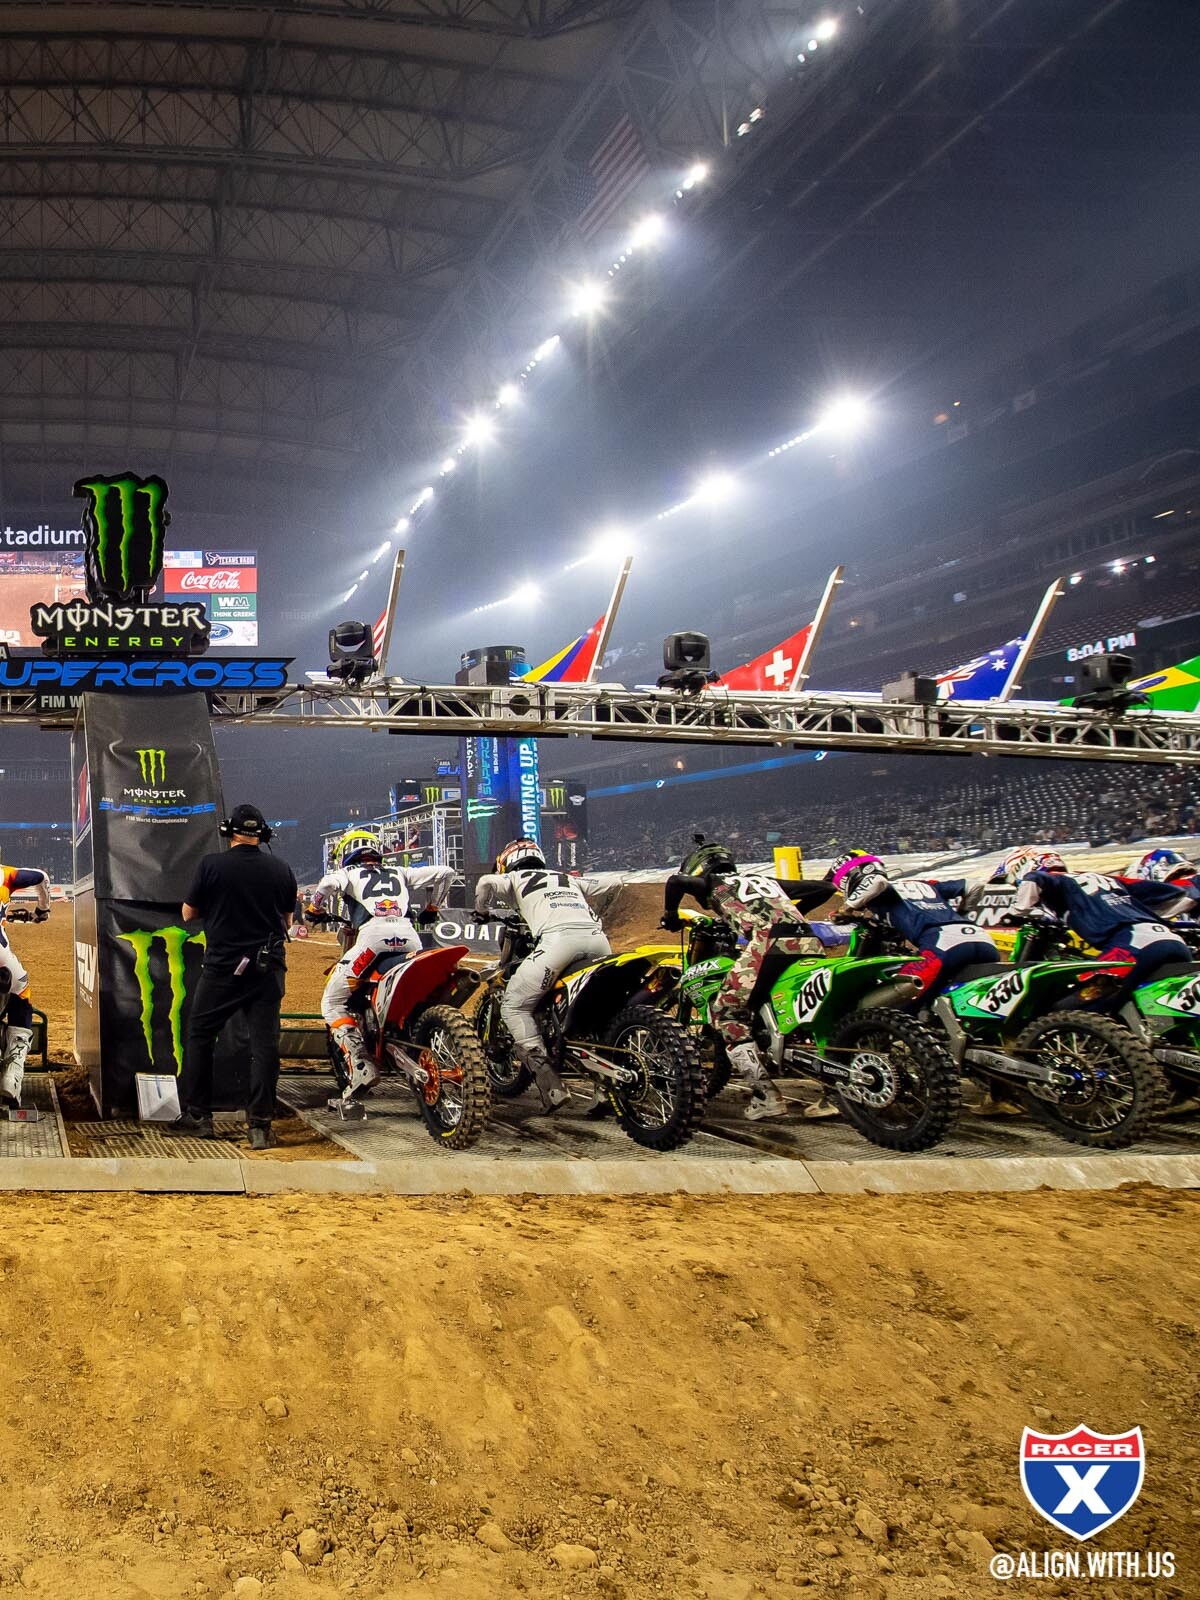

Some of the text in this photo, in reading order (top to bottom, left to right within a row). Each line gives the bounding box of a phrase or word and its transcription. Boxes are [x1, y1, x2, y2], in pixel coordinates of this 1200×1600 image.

[181, 570, 241, 590] Coca-Cola
[36, 602, 207, 632] MONSTER
[64, 636, 185, 648] ENERGY
[1066, 632, 1137, 662] 8:04 PM
[40, 694, 67, 708] FIM
[519, 744, 534, 767] UP
[123, 787, 187, 798] MONSTER
[99, 802, 217, 817] SUPERCROSS
[151, 817, 189, 825] Championship
[359, 868, 402, 900] 25
[520, 870, 571, 899] 21
[798, 972, 828, 1019] 280
[986, 975, 1024, 1013] 330
